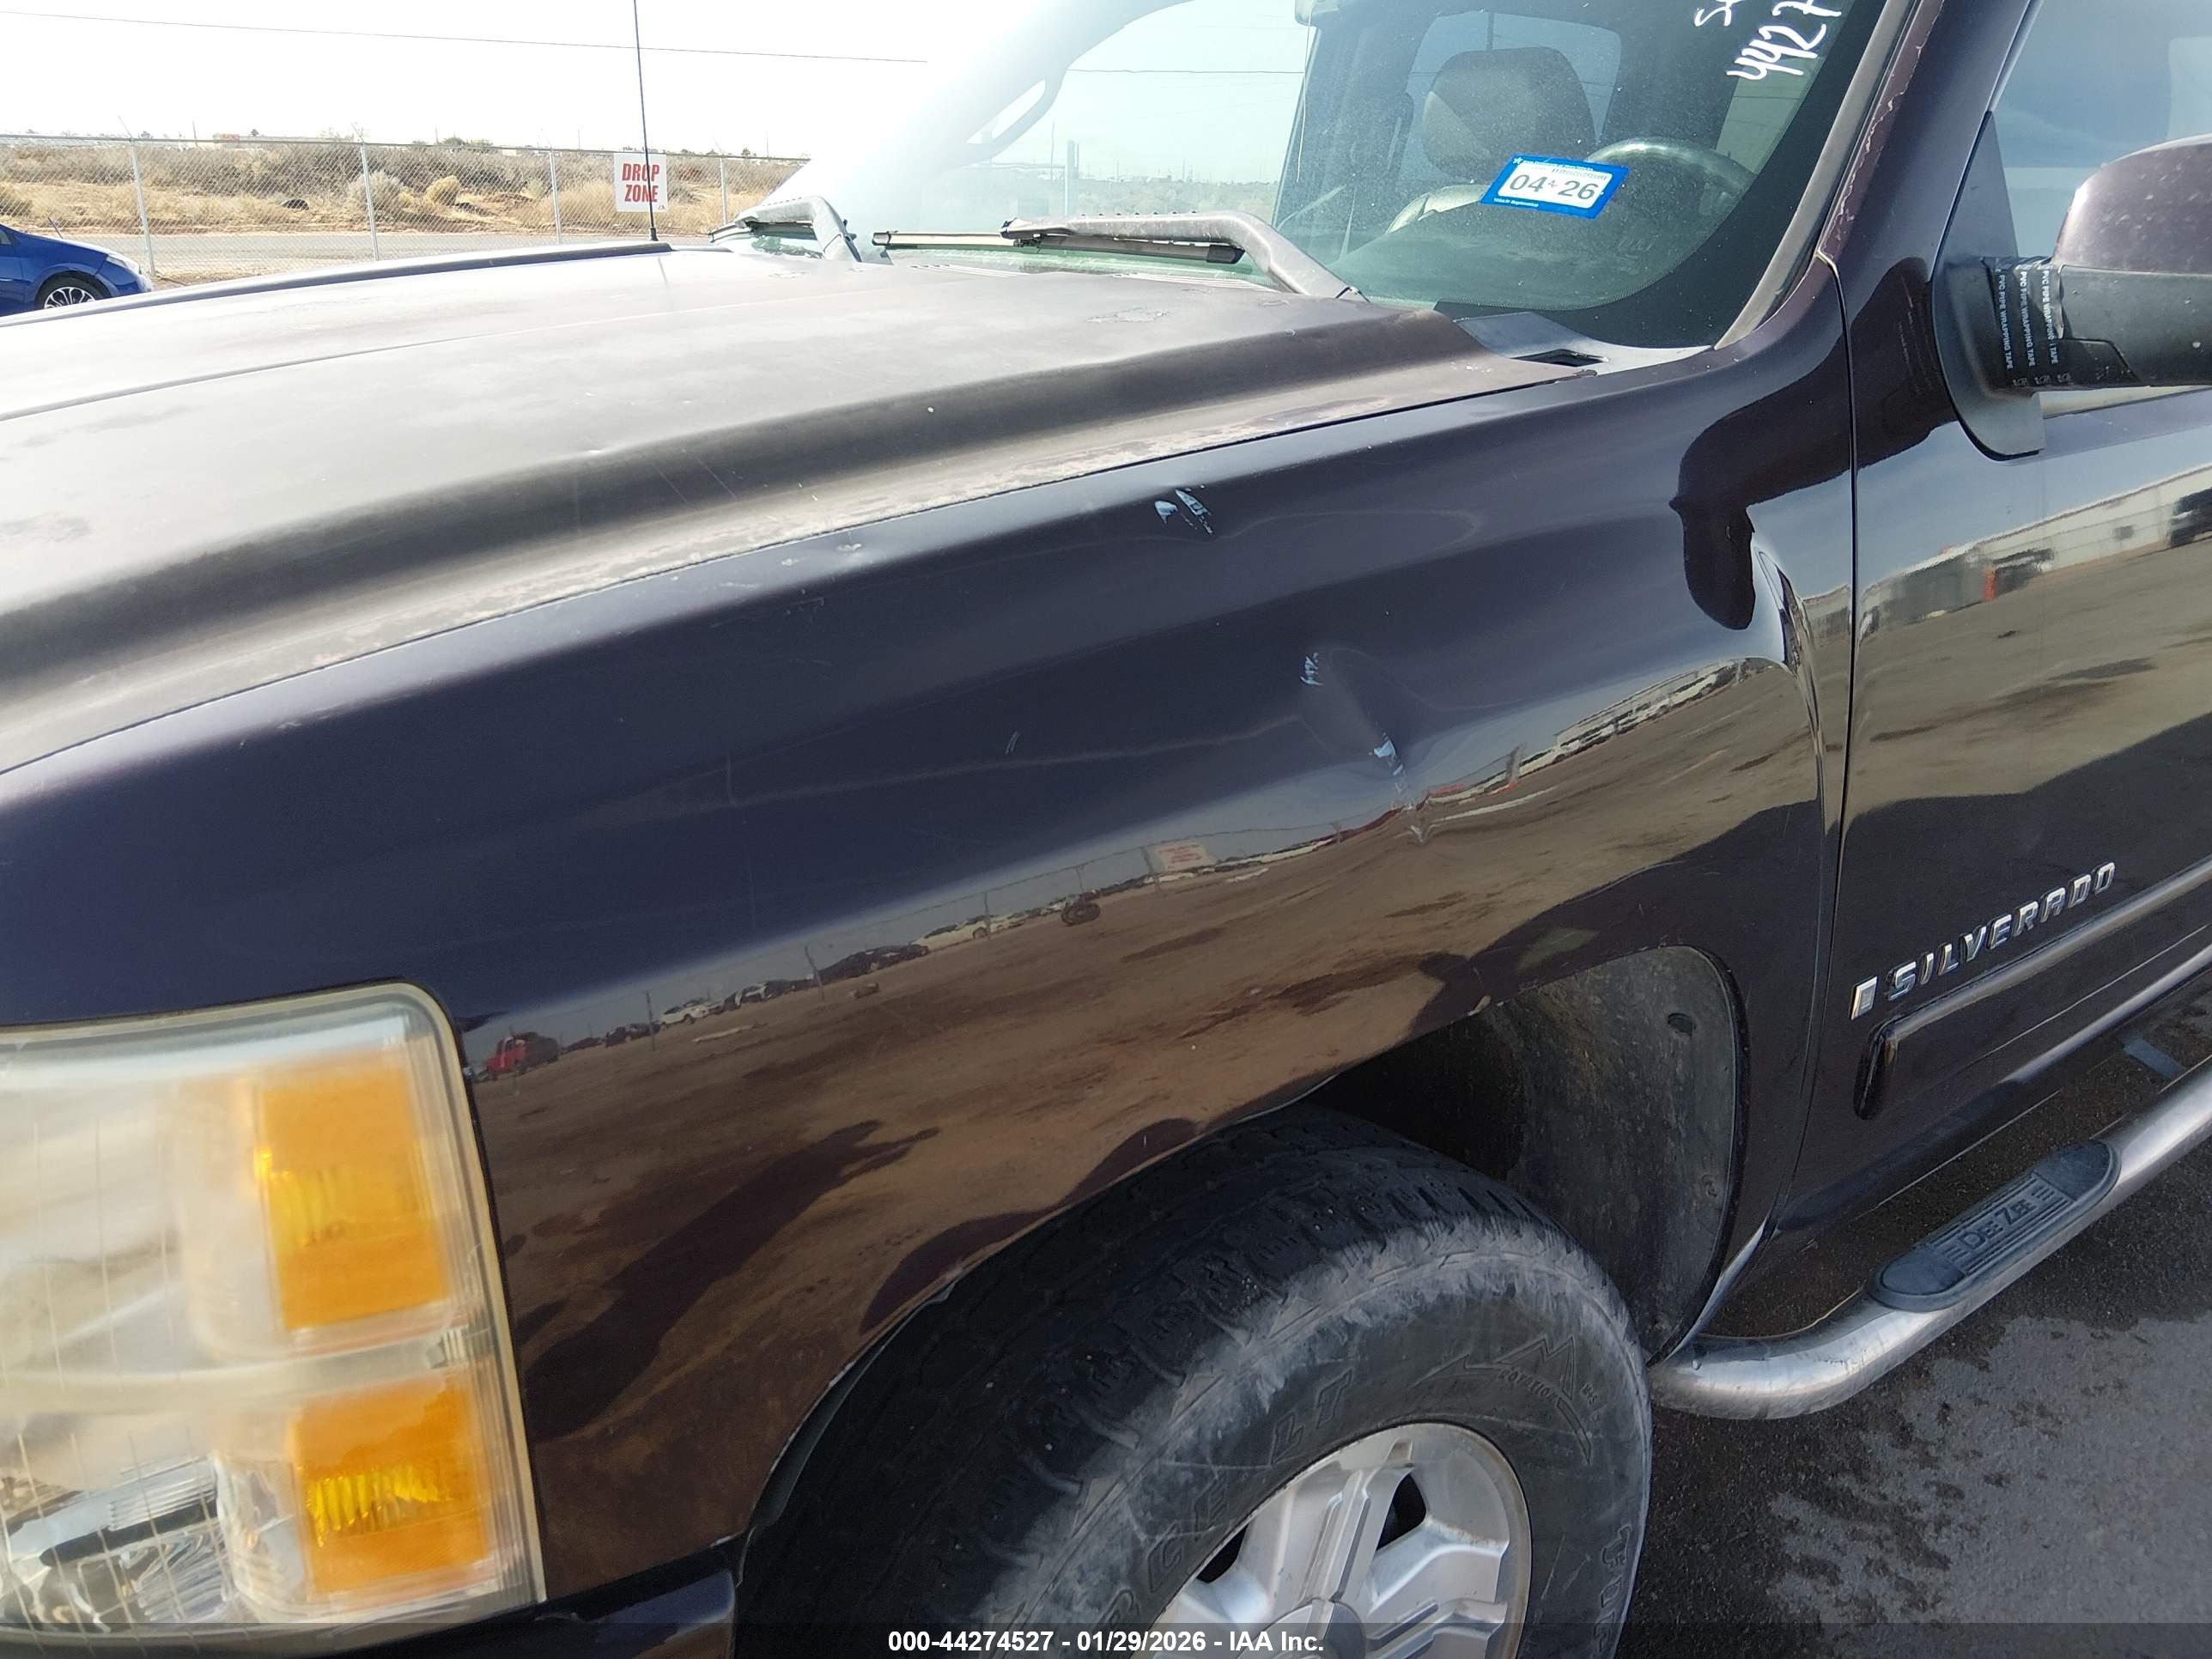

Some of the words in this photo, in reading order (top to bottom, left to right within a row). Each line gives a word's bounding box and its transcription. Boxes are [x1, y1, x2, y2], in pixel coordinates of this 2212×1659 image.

[622, 163, 660, 182] DROP
[624, 184, 659, 203] ZONE
[1509, 173, 1548, 193] 04
[1558, 179, 1600, 200] 26
[2000, 310, 2012, 351] WRAPPING
[2005, 351, 2014, 370] TAPE
[2027, 349, 2036, 367] TAPE
[2049, 346, 2059, 365] TAPE
[1886, 861, 2116, 1002] SILVERADO
